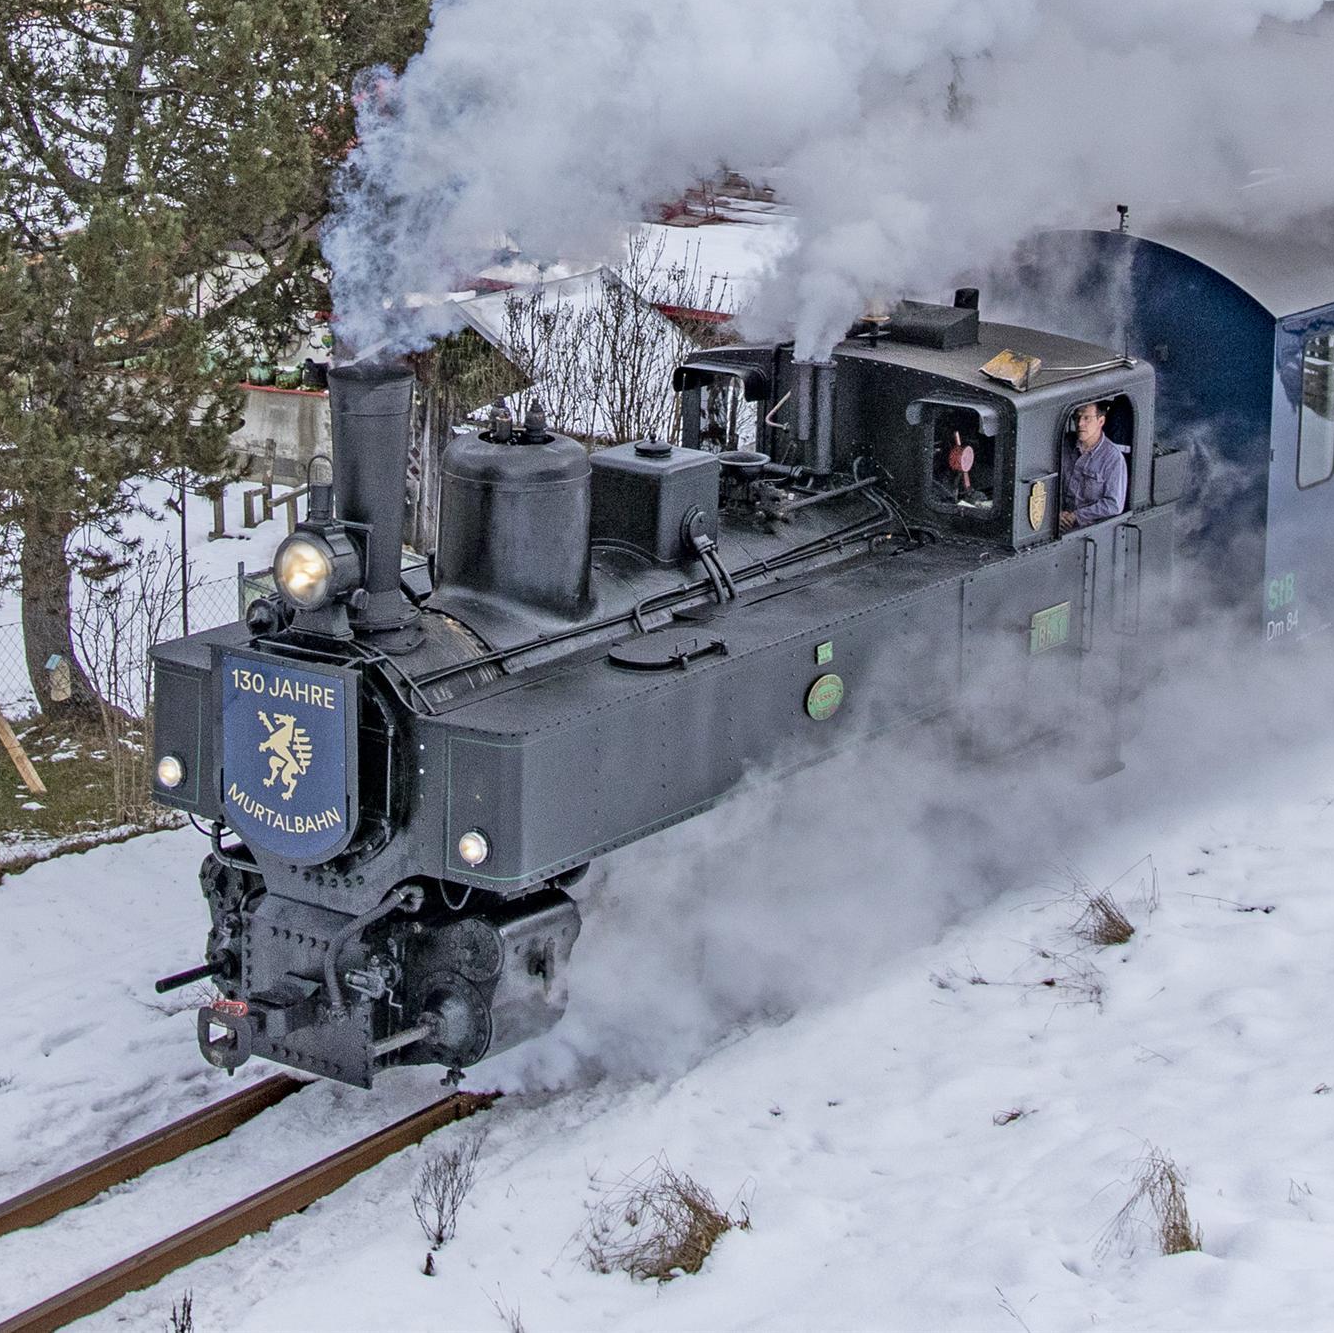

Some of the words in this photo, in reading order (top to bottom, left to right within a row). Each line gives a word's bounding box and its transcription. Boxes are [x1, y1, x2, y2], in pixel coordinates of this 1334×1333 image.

[1267, 620, 1284, 641] Dm
[1286, 609, 1299, 632] 84
[231, 669, 265, 694] 130
[269, 677, 335, 710] JAHRE
[227, 782, 342, 834] MURTALBAHN
